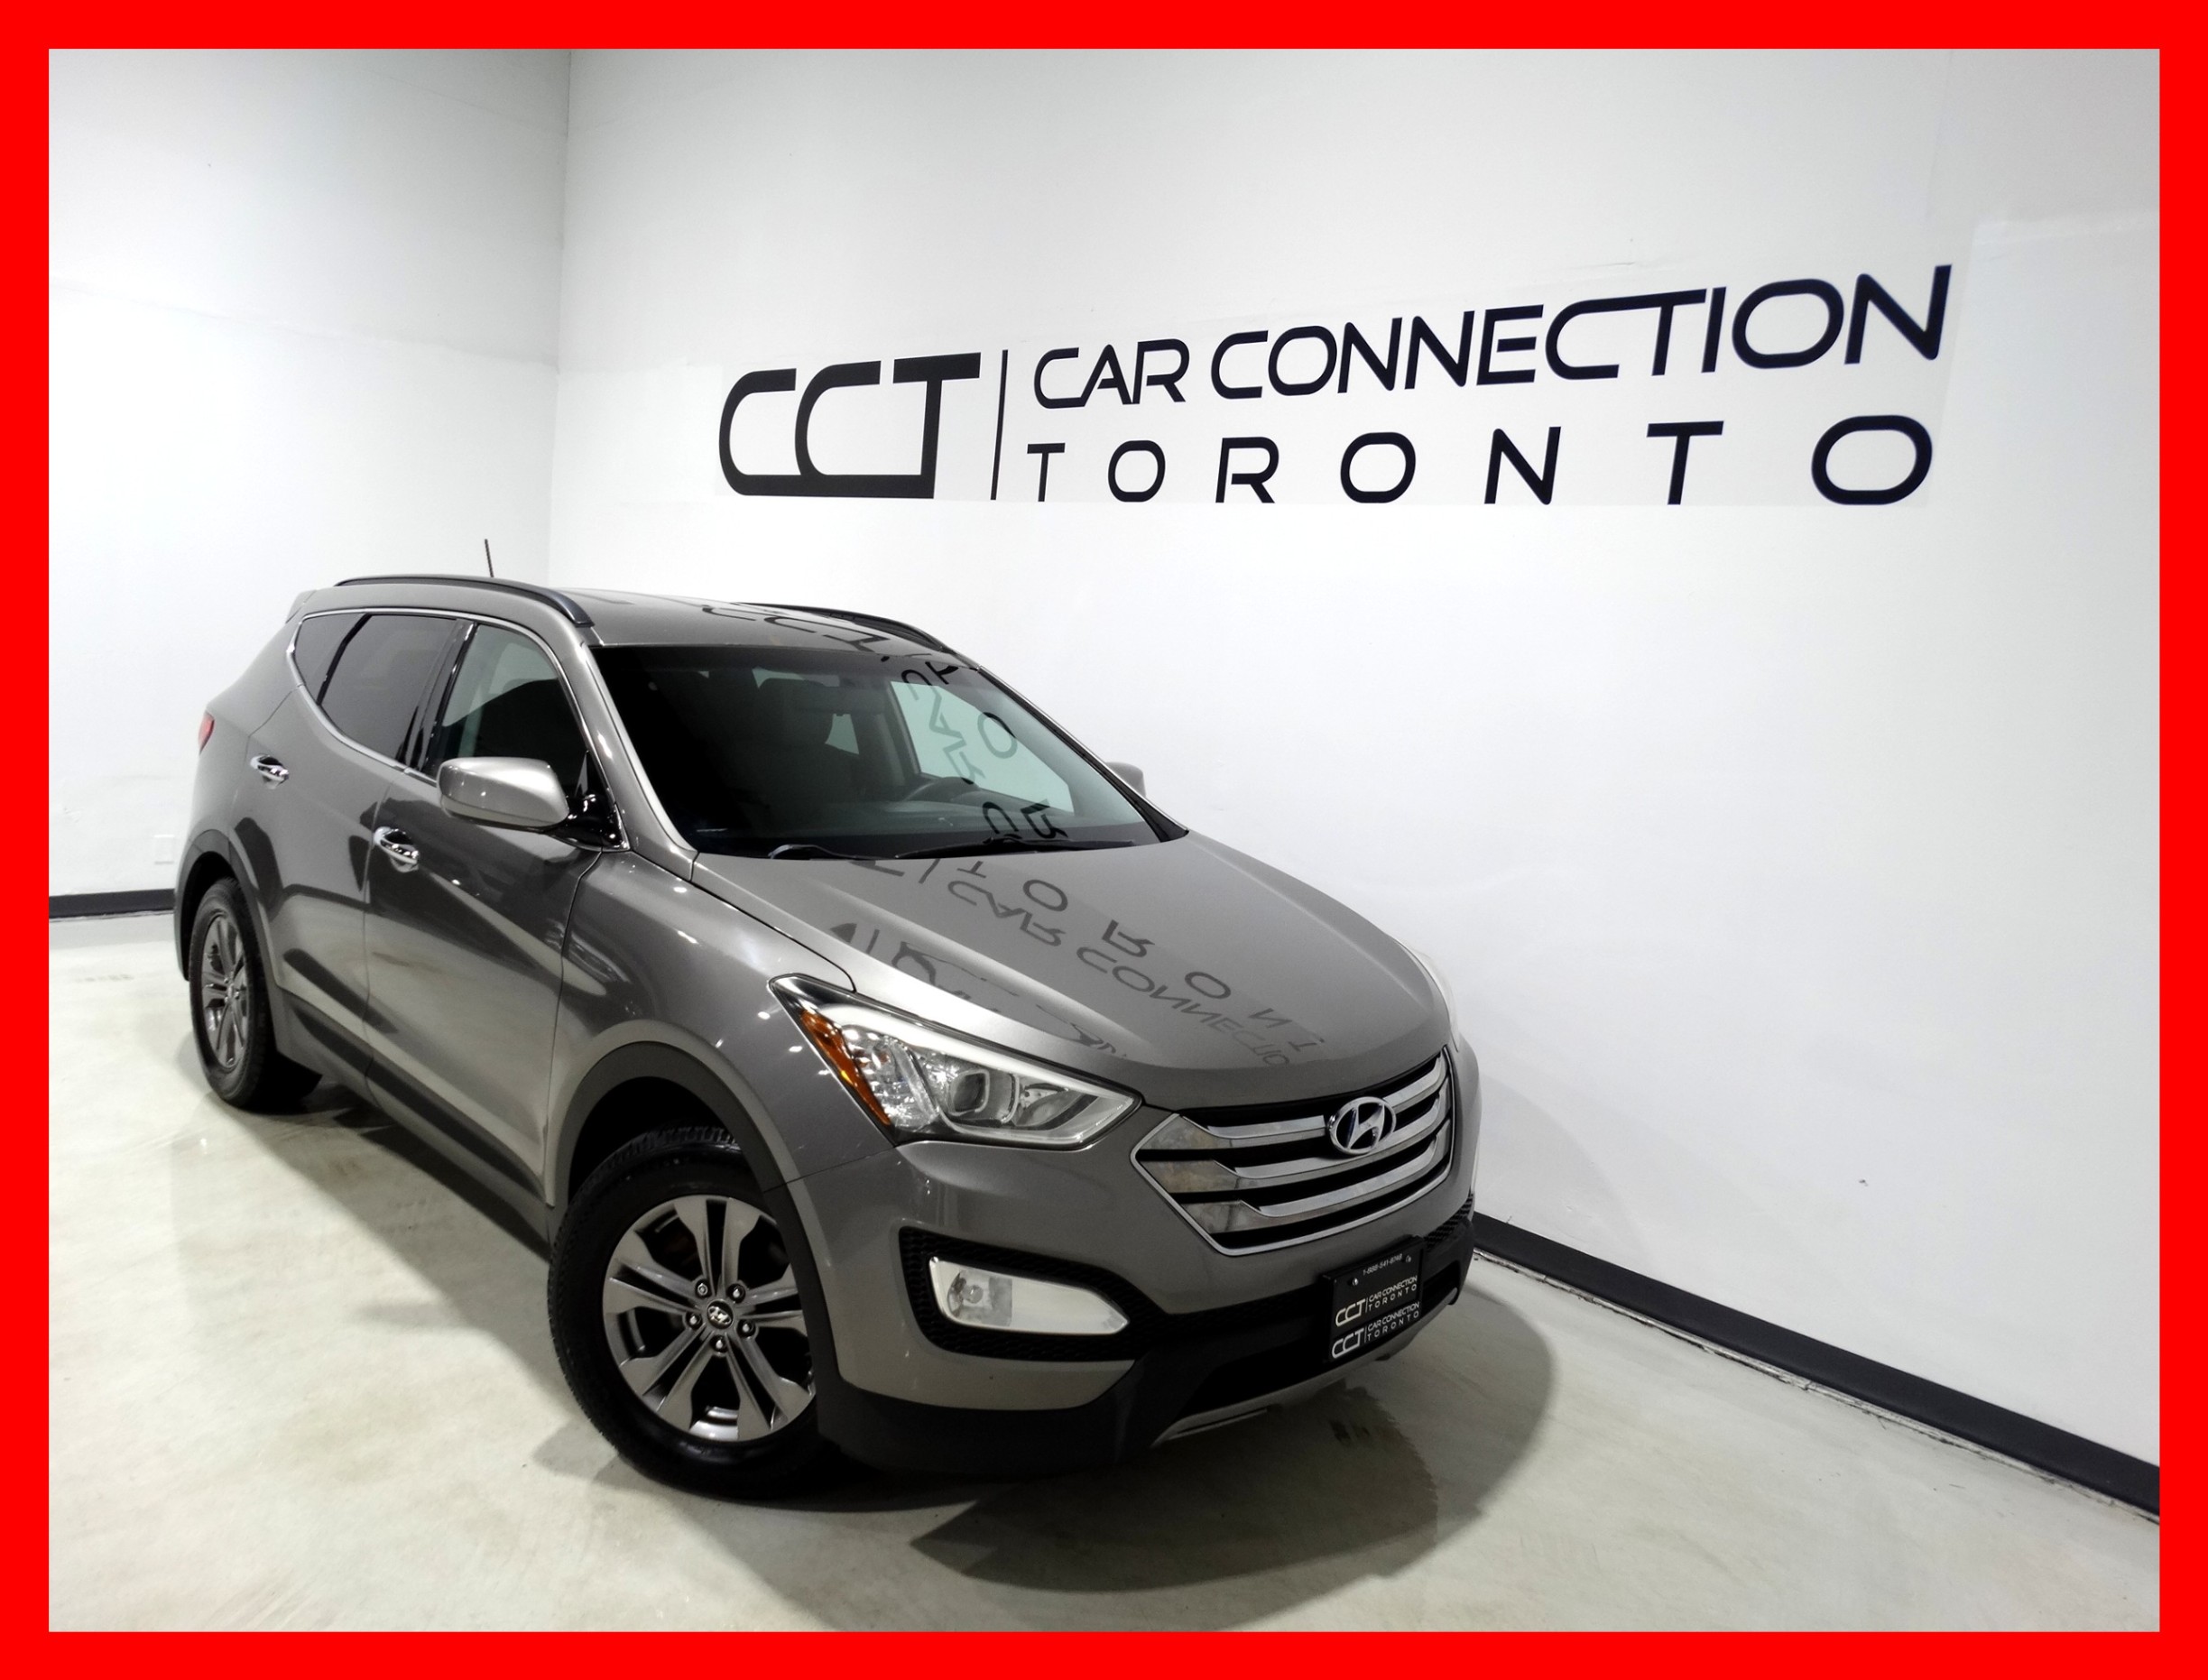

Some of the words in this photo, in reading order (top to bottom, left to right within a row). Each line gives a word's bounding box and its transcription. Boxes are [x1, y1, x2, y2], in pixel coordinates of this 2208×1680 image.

[1033, 337, 1191, 410] CAR
[1210, 264, 1953, 399] CONNECTION
[719, 352, 982, 499] CCT
[1027, 414, 1935, 505] TORONTO
[1369, 1290, 1382, 1303] CAR
[1369, 1283, 1418, 1311] TORONTO
[1335, 1298, 1366, 1327] CCT
[1367, 1319, 1382, 1333] CAR
[1367, 1310, 1419, 1342] TORONTO
[1332, 1328, 1364, 1359] CCT
